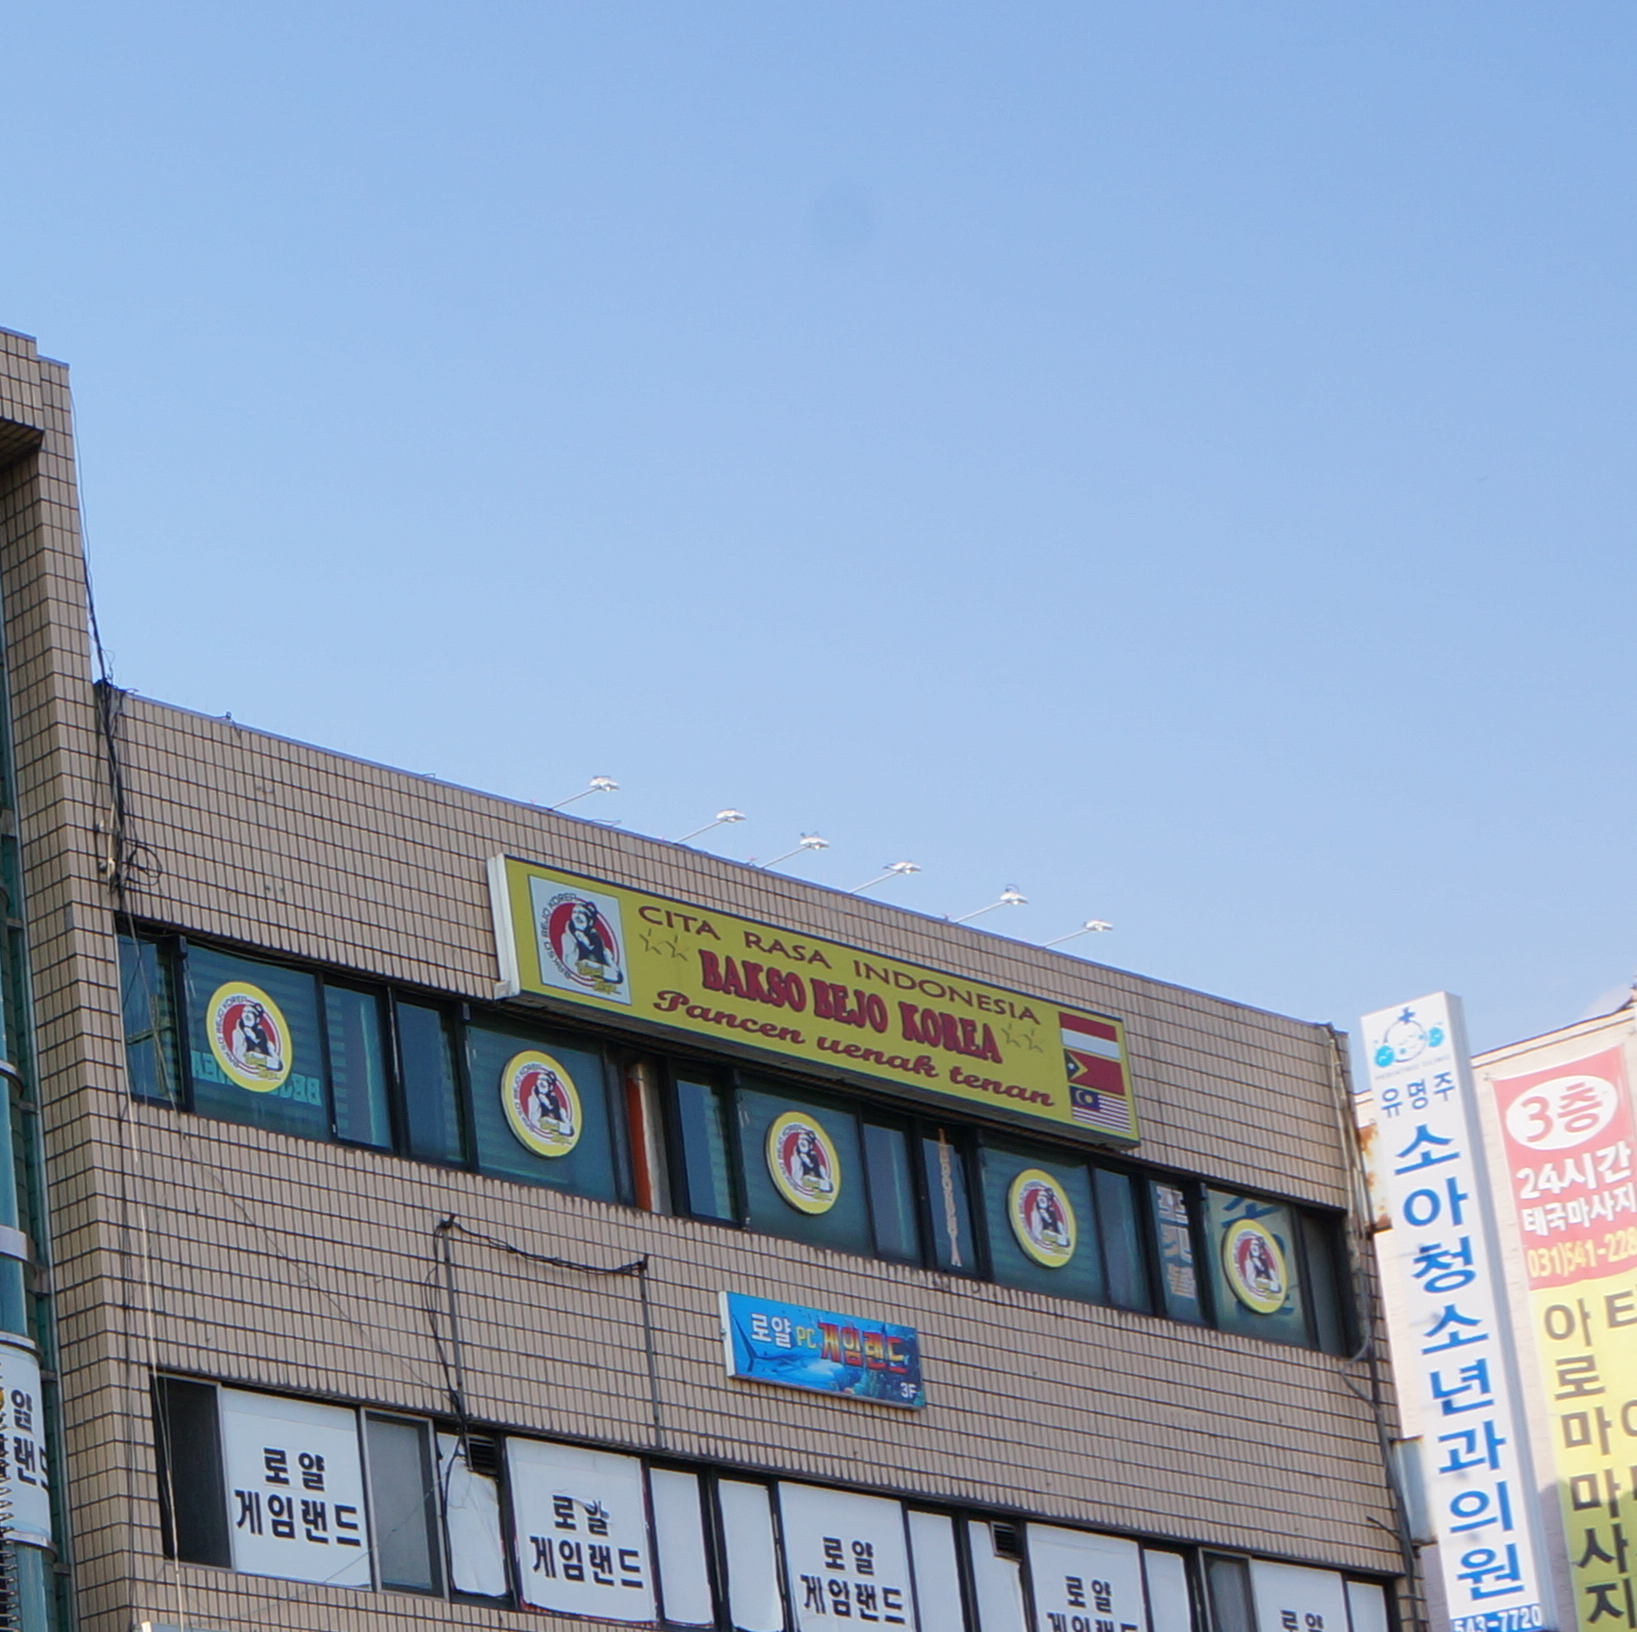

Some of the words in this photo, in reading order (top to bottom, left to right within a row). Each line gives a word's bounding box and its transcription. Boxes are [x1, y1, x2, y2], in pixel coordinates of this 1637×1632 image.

[637, 903, 722, 941] CITA
[743, 930, 832, 969] RASA
[854, 960, 1043, 1026] INDONESIA
[700, 949, 807, 1012] BAKSO
[810, 977, 889, 1033] BEJO
[901, 1002, 1004, 1065] KOREA
[653, 988, 806, 1046] Pancen
[950, 1060, 1055, 1108] tenan
[1380, 1071, 1457, 1119] 유명주
[1521, 1082, 1603, 1143] 3층
[1516, 1140, 1632, 1199] 24시간
[751, 1313, 792, 1349] 로얄
[796, 1326, 818, 1350] PC
[818, 1321, 908, 1375] 게임랜드
[1394, 1124, 1525, 1601] 소아청소년과의원
[899, 1382, 918, 1399] 3F
[263, 1446, 327, 1494] 로얄
[234, 1488, 362, 1548] 게임랜드
[529, 1533, 645, 1590] 게임랜드
[823, 1536, 875, 1577] 로얄
[800, 1571, 904, 1626] 게임랜드
[1065, 1575, 1113, 1609] 로얄
